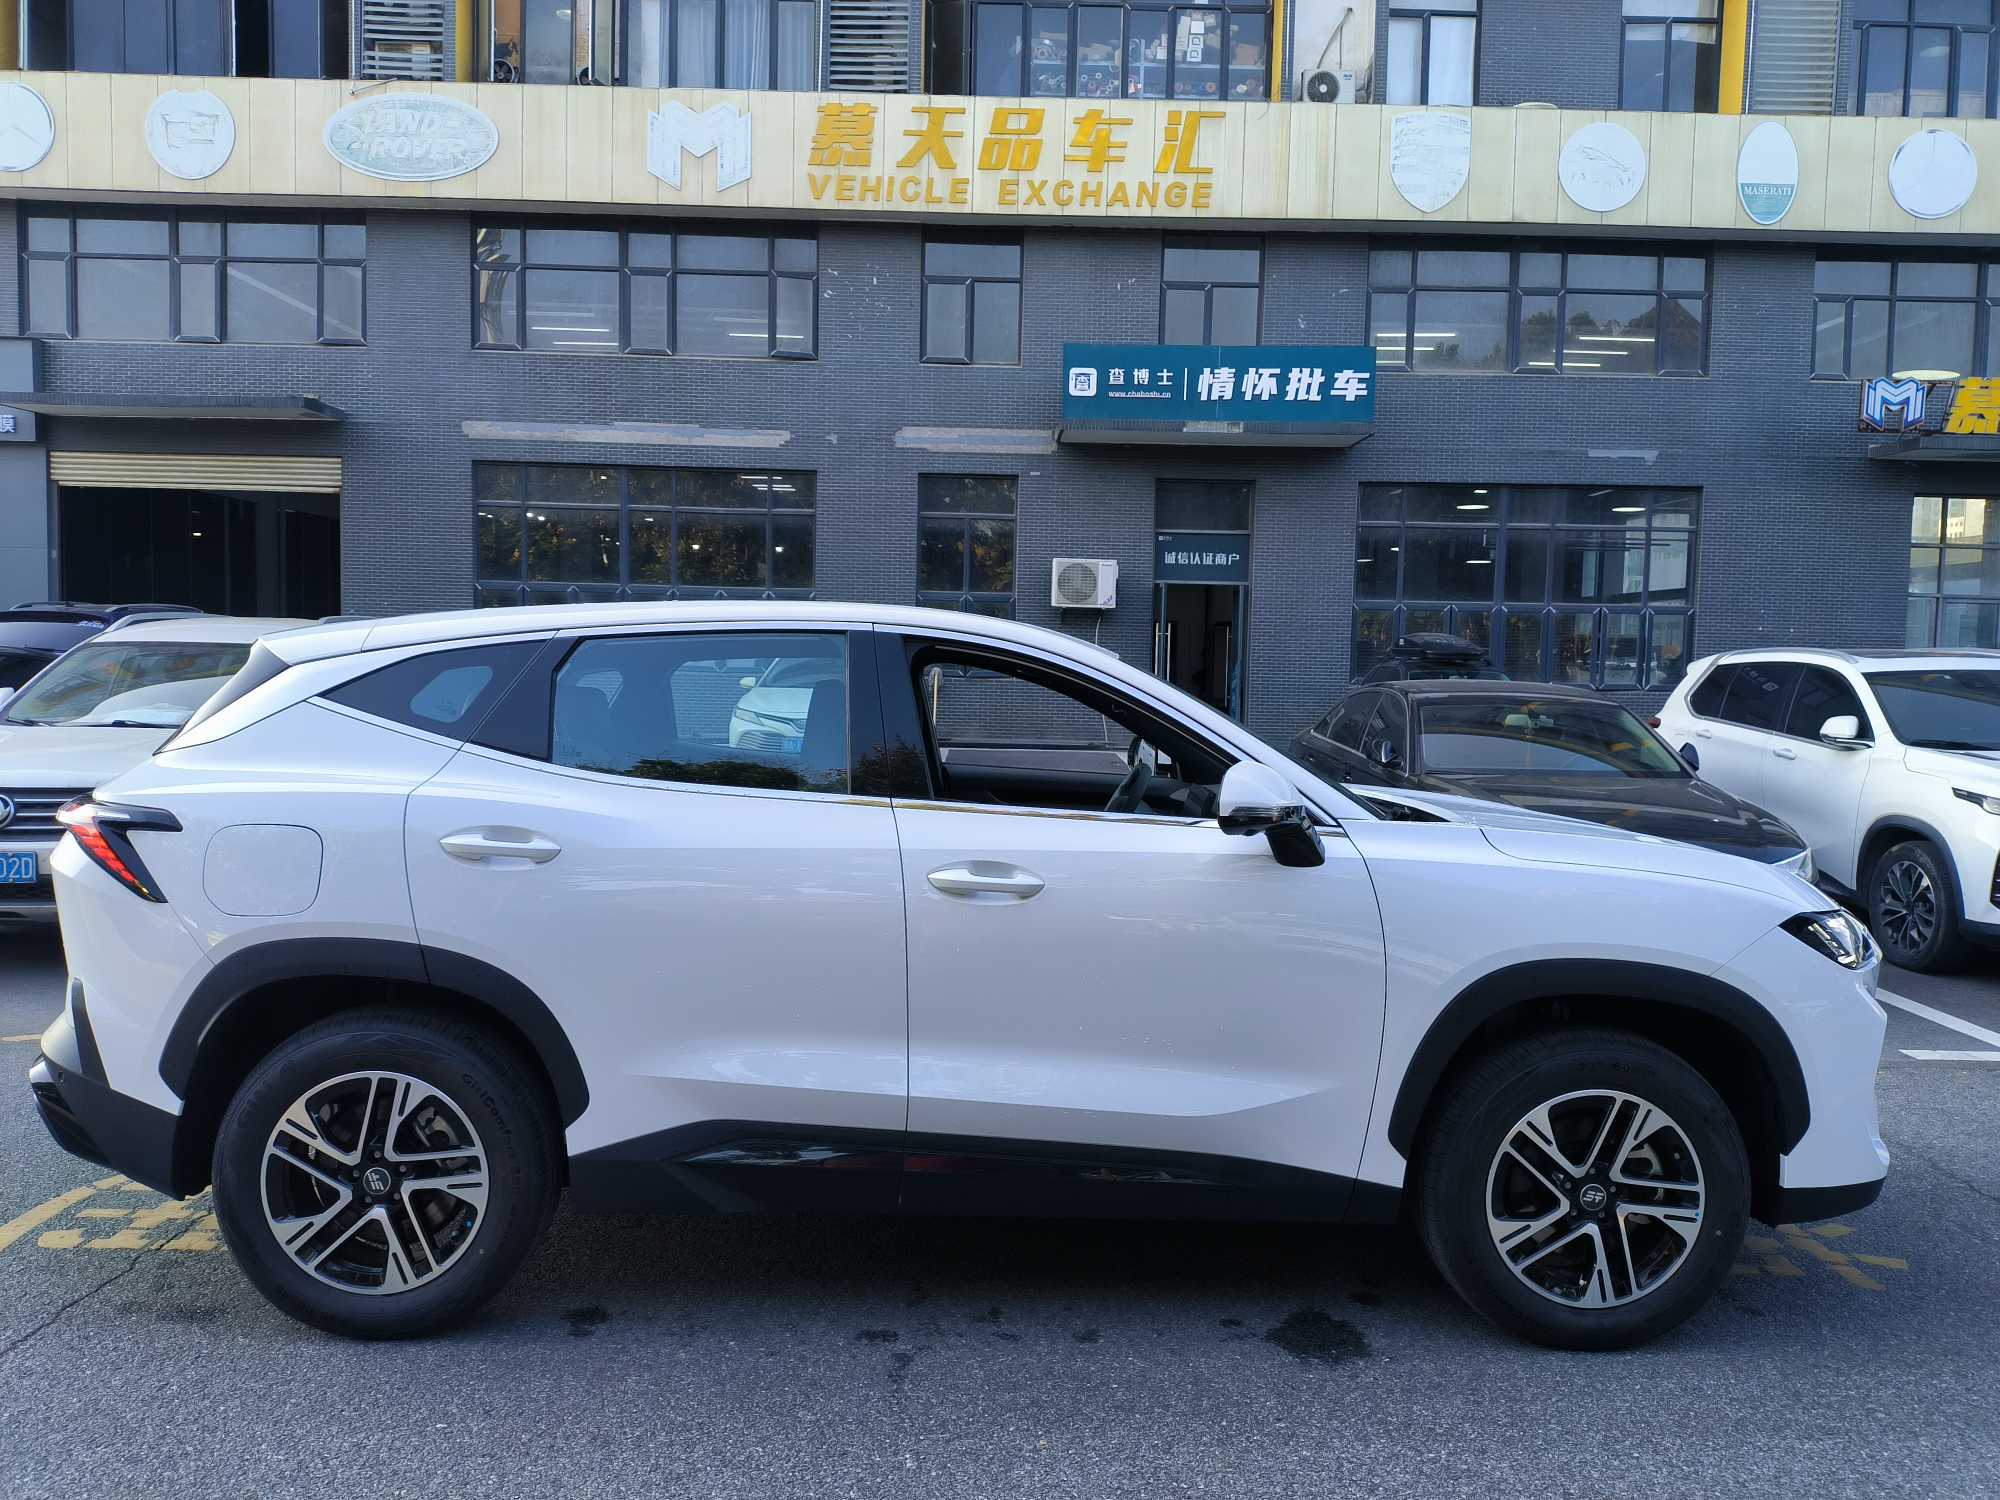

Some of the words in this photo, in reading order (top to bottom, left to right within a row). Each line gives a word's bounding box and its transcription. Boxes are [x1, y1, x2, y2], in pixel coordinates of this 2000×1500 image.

[807, 102, 1226, 174] 慕天品车汇
[807, 172, 970, 204] VEHICLE
[997, 178, 1213, 208] EXCHANGE
[1743, 185, 1793, 196] MASERATI
[1108, 368, 1174, 385] 查博士
[1197, 367, 1370, 402] 情怀批车
[1164, 551, 1240, 565] 诚信认证商户
